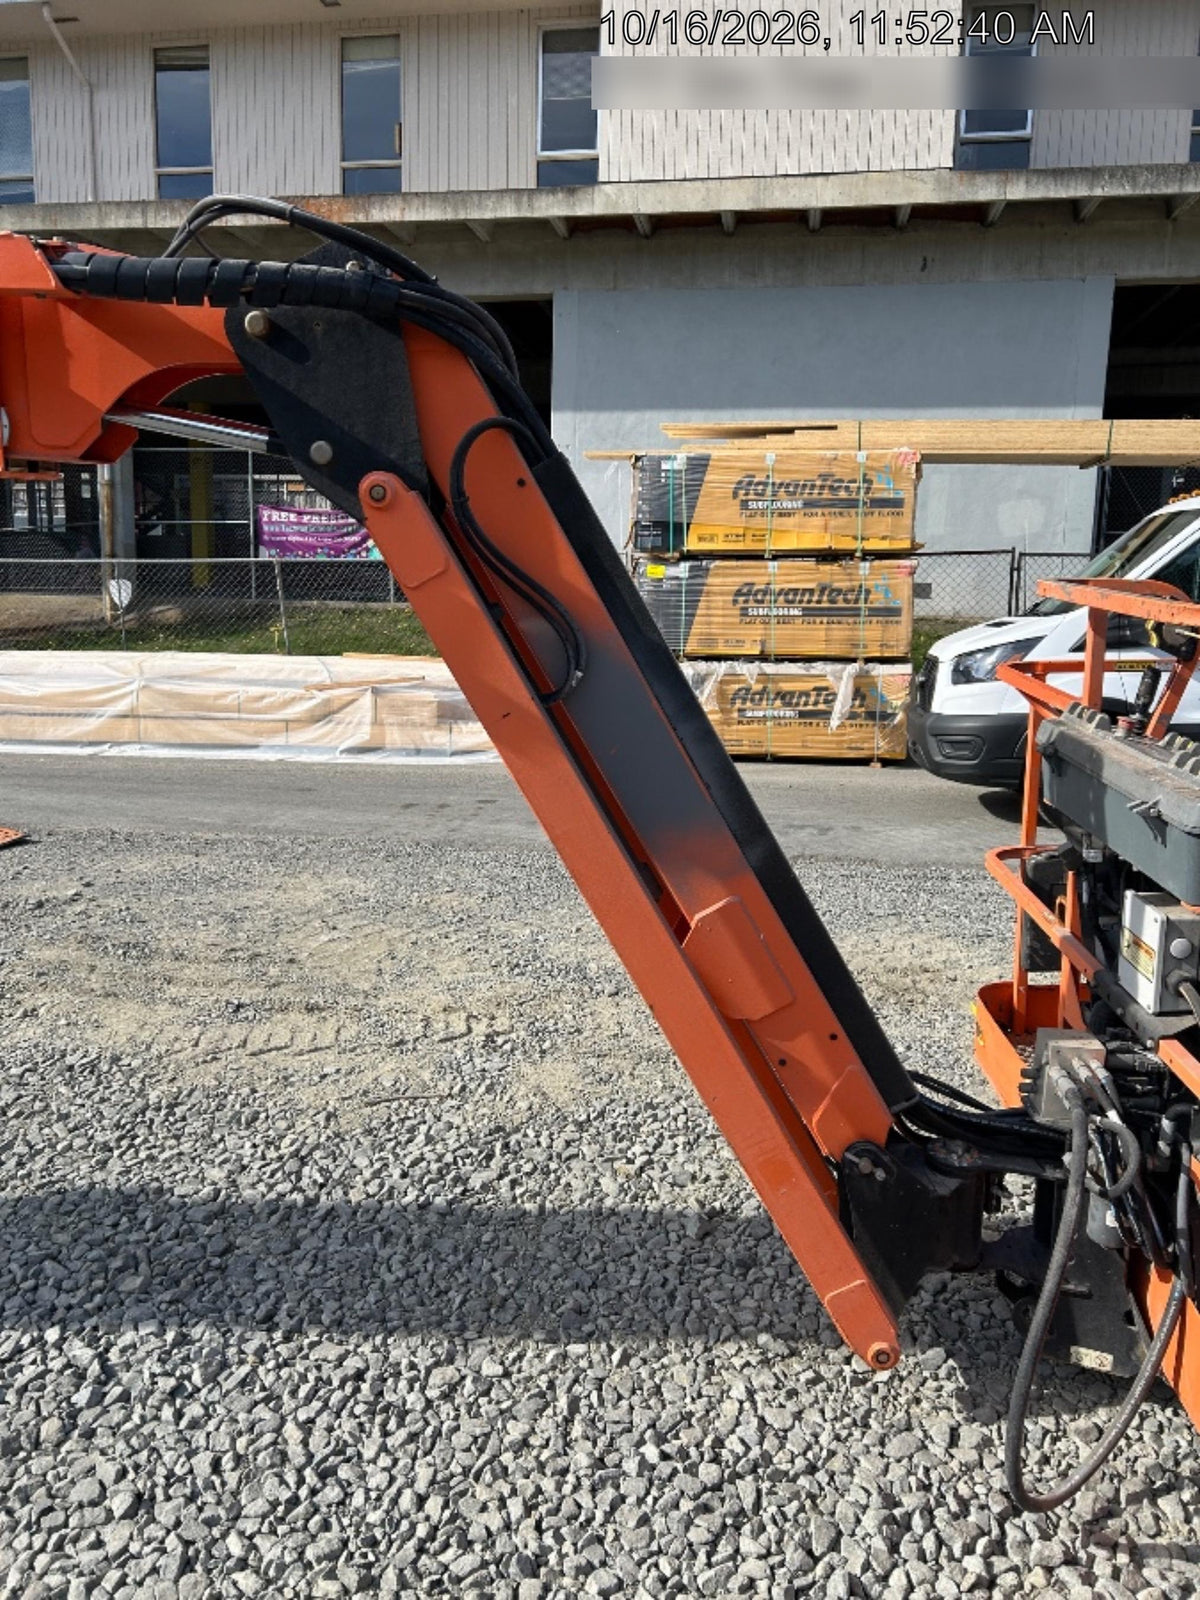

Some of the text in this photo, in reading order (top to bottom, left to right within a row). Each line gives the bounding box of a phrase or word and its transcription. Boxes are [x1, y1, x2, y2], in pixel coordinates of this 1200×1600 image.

[732, 472, 874, 500] AdvanTech
[262, 510, 298, 522] FREE
[731, 582, 872, 606] AdvanTech
[730, 685, 867, 707] AdvanTeh
